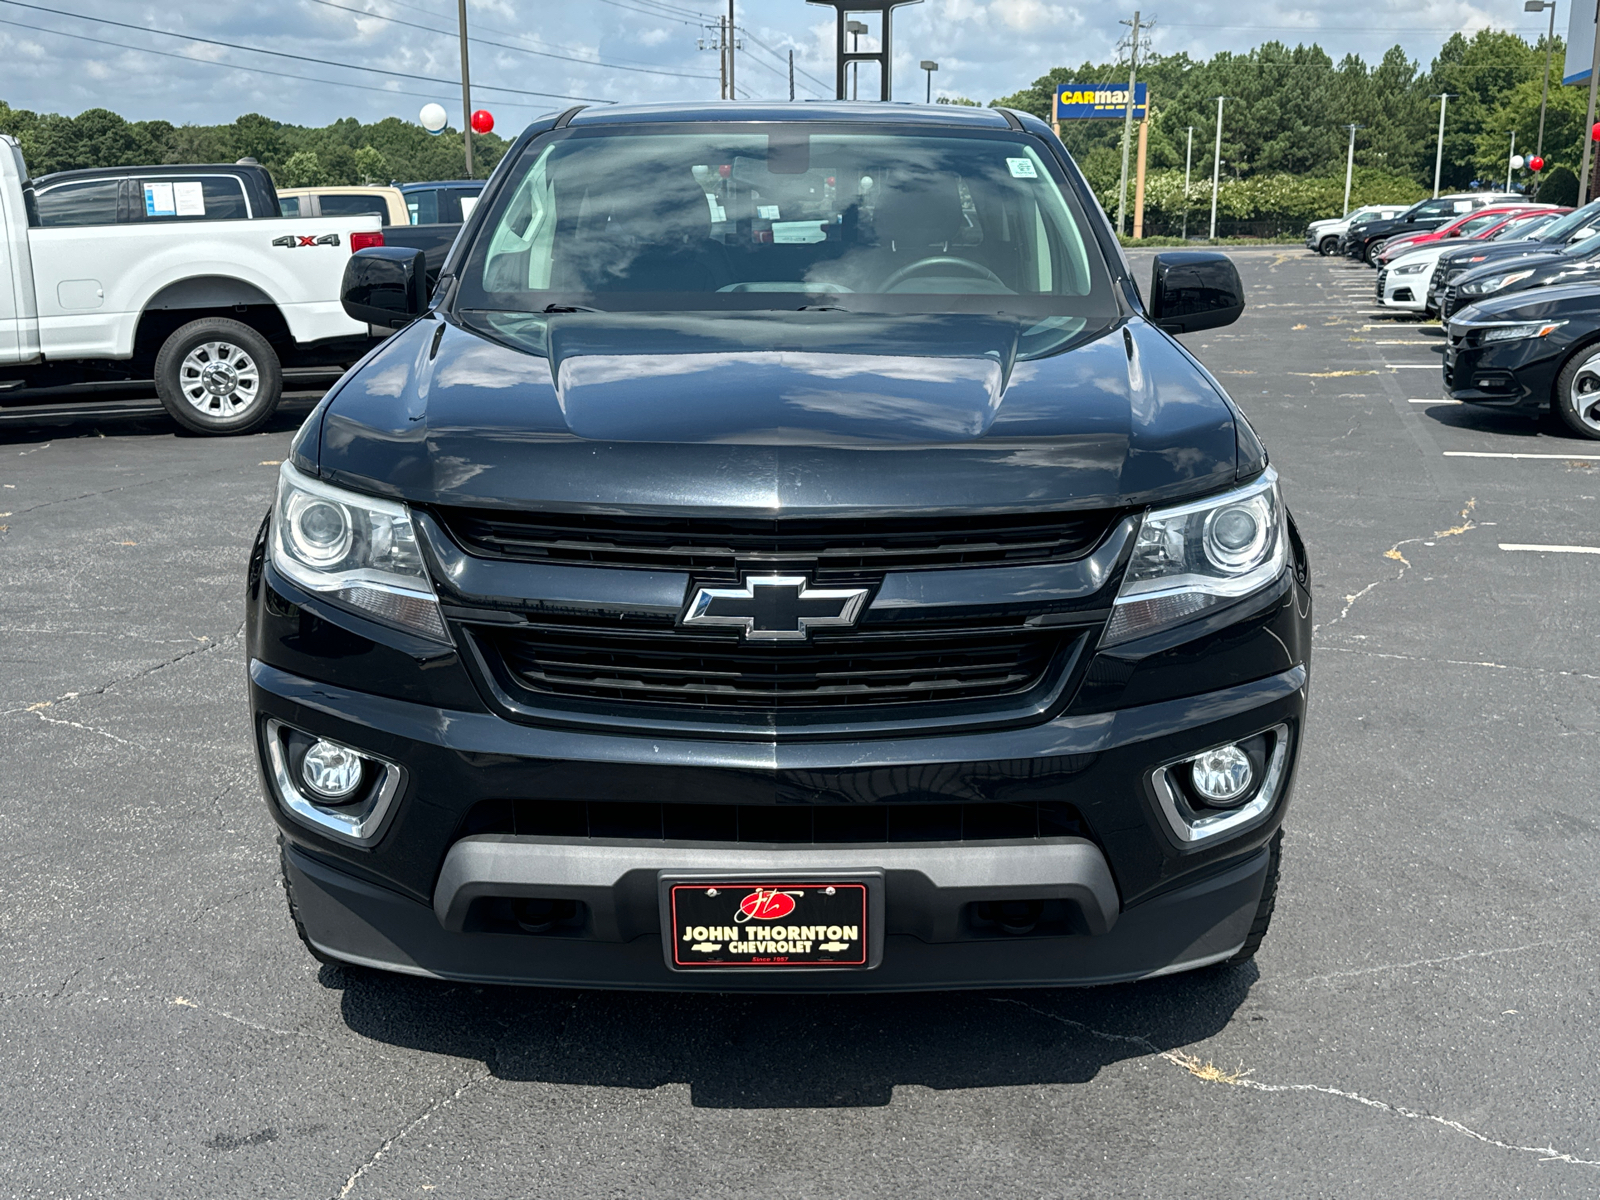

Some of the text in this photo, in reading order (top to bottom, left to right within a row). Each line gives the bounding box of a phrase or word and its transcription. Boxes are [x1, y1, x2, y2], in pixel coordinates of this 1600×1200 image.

[682, 925, 859, 941] JOHN THORNTON
[728, 941, 813, 954] CHEVROLET
